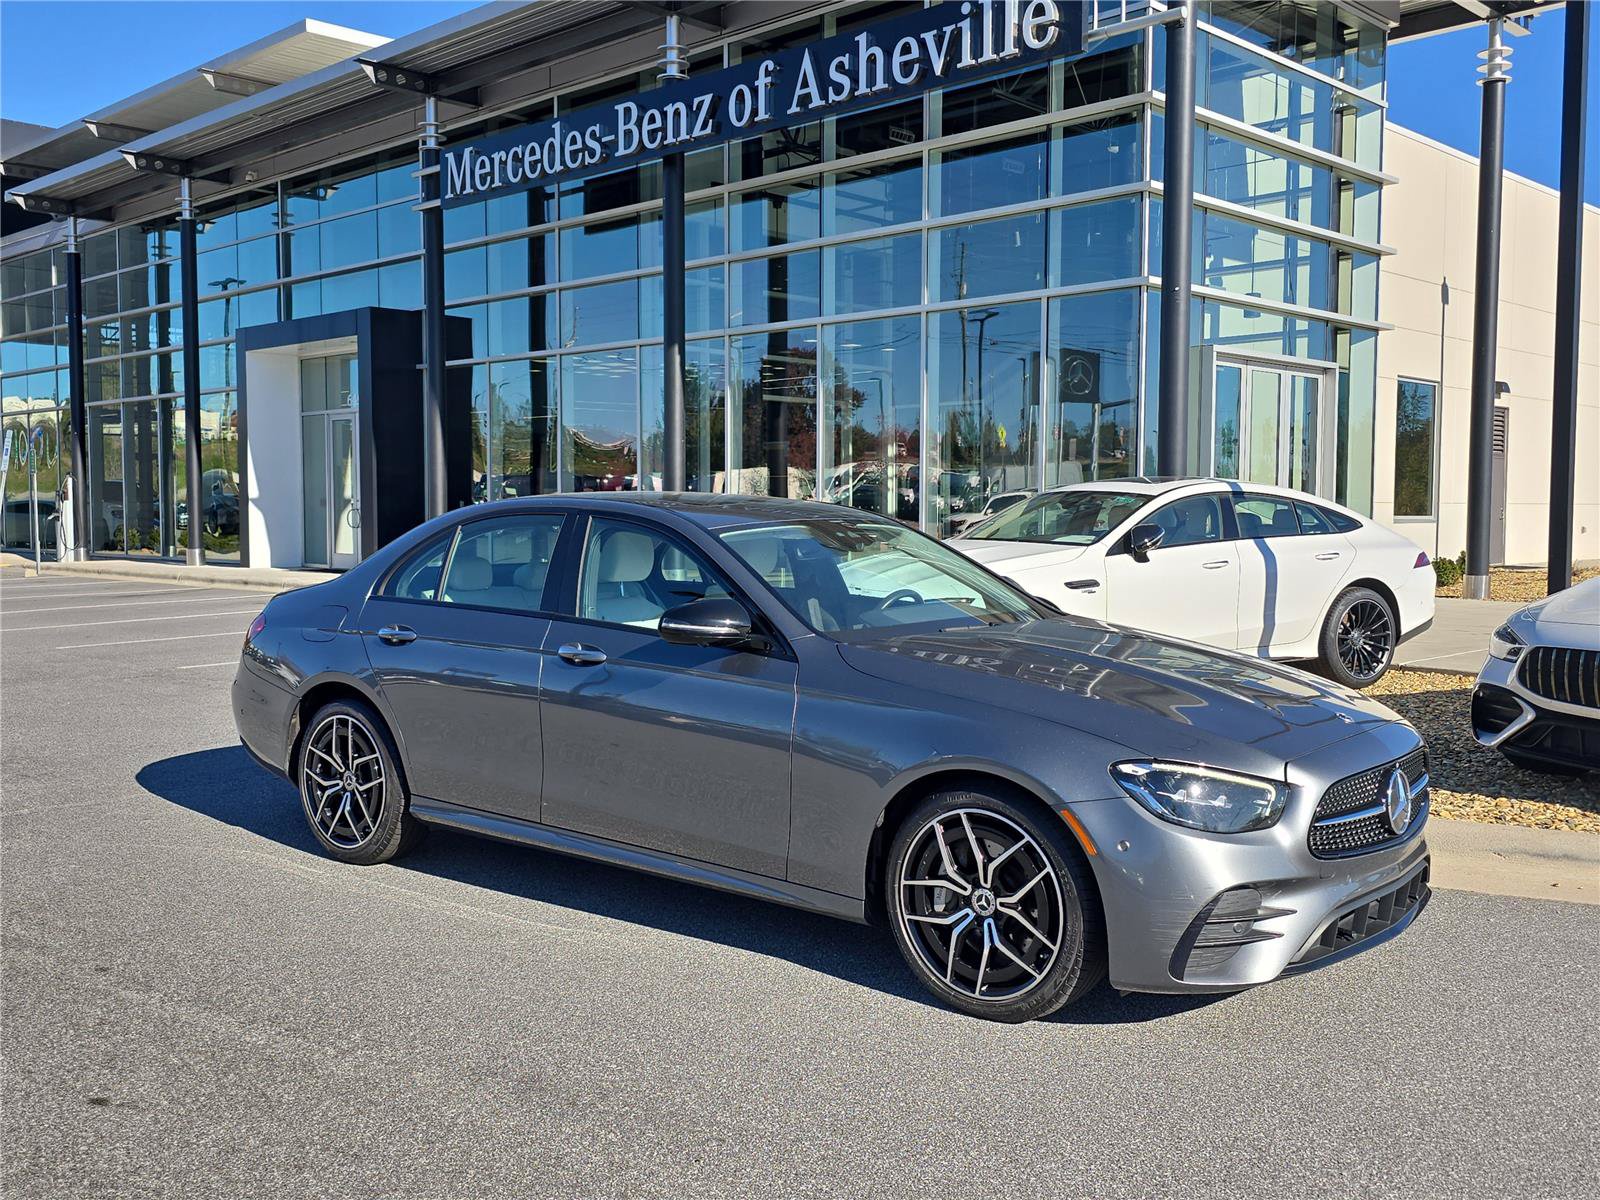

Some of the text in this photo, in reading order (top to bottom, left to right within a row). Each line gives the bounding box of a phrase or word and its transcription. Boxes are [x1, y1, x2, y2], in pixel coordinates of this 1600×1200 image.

[444, 0, 1060, 199] Mercedes-Benz of Asheville
